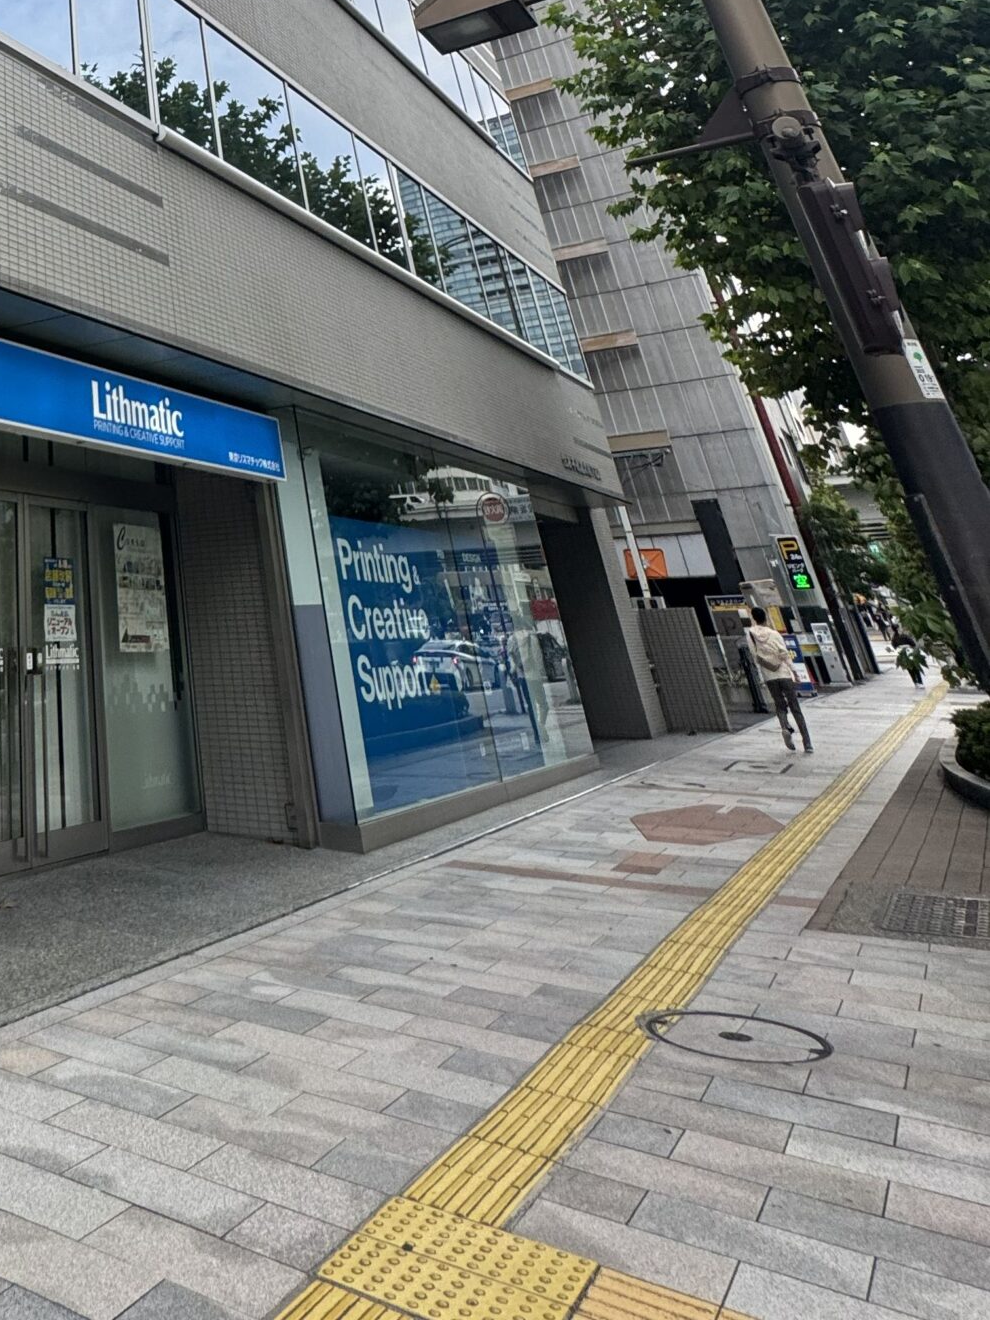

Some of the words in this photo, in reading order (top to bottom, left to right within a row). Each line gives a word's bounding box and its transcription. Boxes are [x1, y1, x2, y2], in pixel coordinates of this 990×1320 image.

[91, 380, 185, 438] Lithmatic
[93, 419, 124, 436] PRINTING
[124, 425, 130, 438] &
[130, 427, 160, 445] CREATIVE
[159, 435, 185, 450] SUPPORT
[336, 537, 413, 594] Printing
[412, 565, 421, 586] &
[779, 540, 798, 560] P
[347, 594, 430, 640] Creative
[45, 643, 80, 659] Lithmatic
[357, 654, 431, 710] Support
